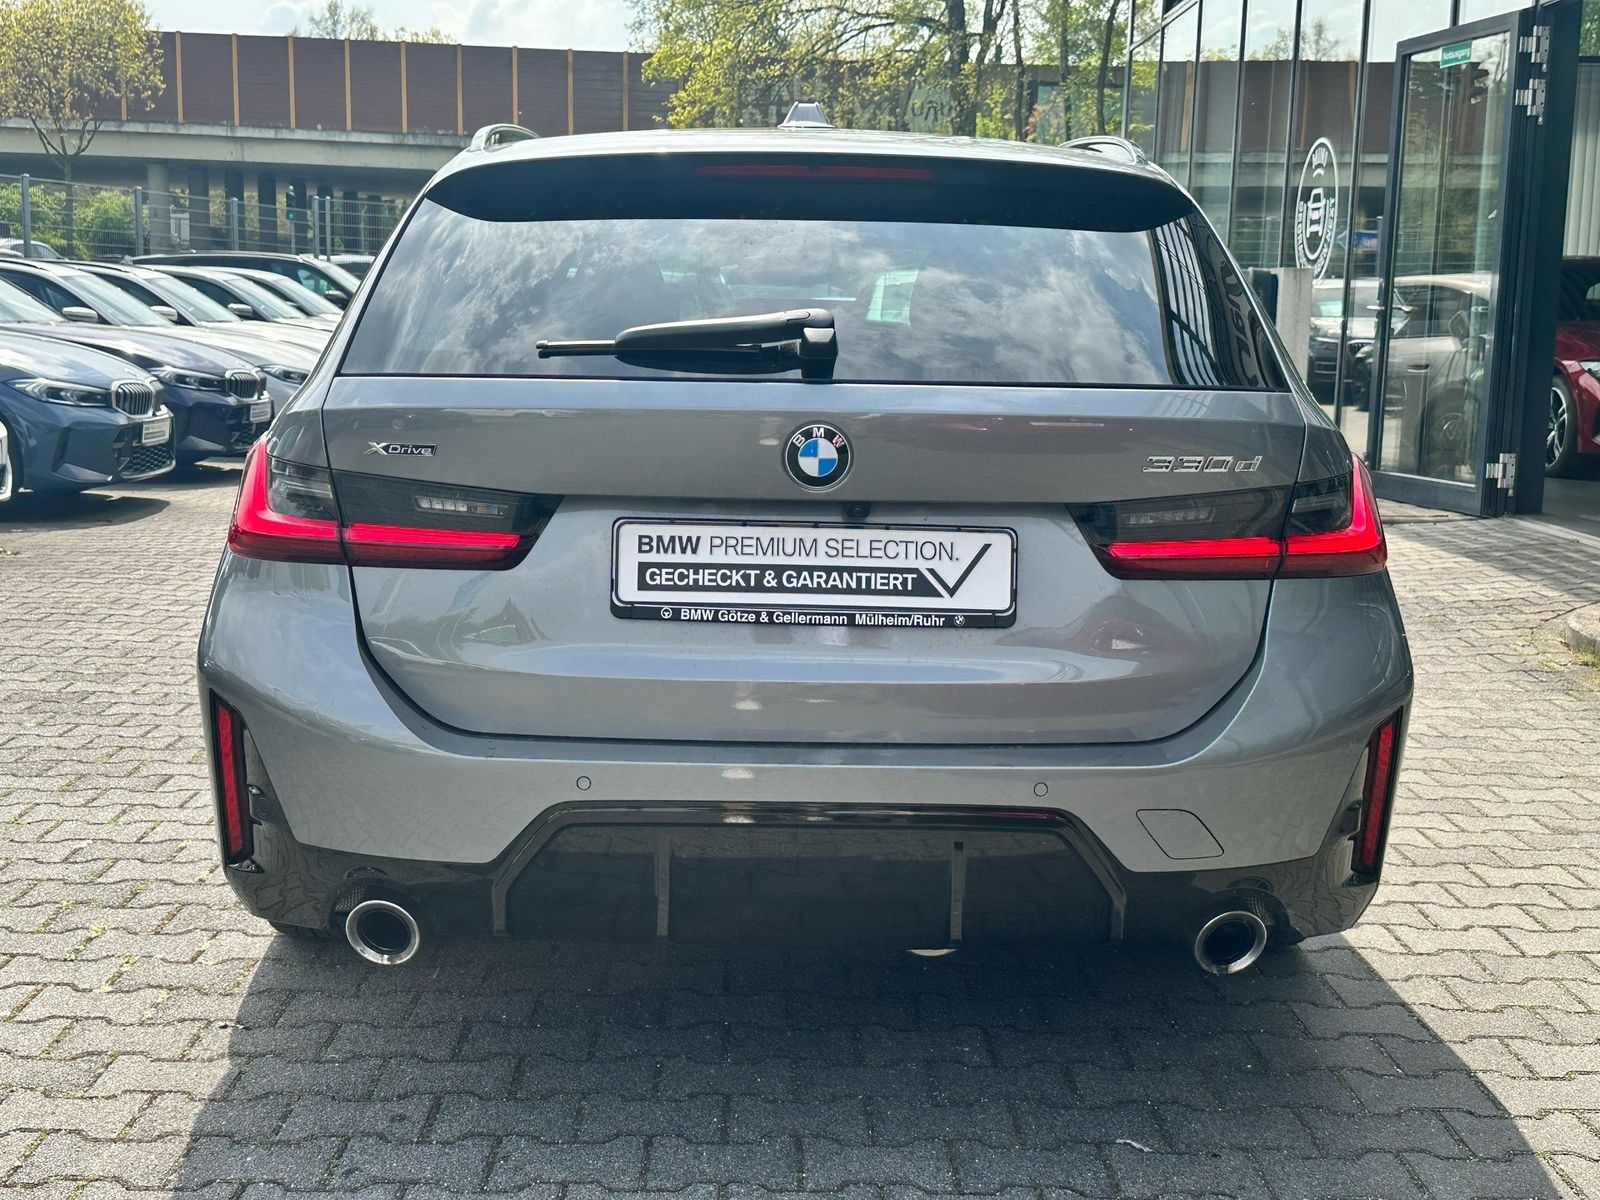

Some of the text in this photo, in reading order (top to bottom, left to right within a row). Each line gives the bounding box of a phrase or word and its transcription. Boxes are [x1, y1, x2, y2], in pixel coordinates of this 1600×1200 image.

[793, 427, 845, 448] BMW
[637, 534, 701, 555] BMW
[709, 535, 818, 558] PREMIUM
[645, 567, 918, 591] GECHECKT & GARANTIERT
[680, 608, 946, 627] BMW Götze & Gellermann Mülheim/Ruhr
